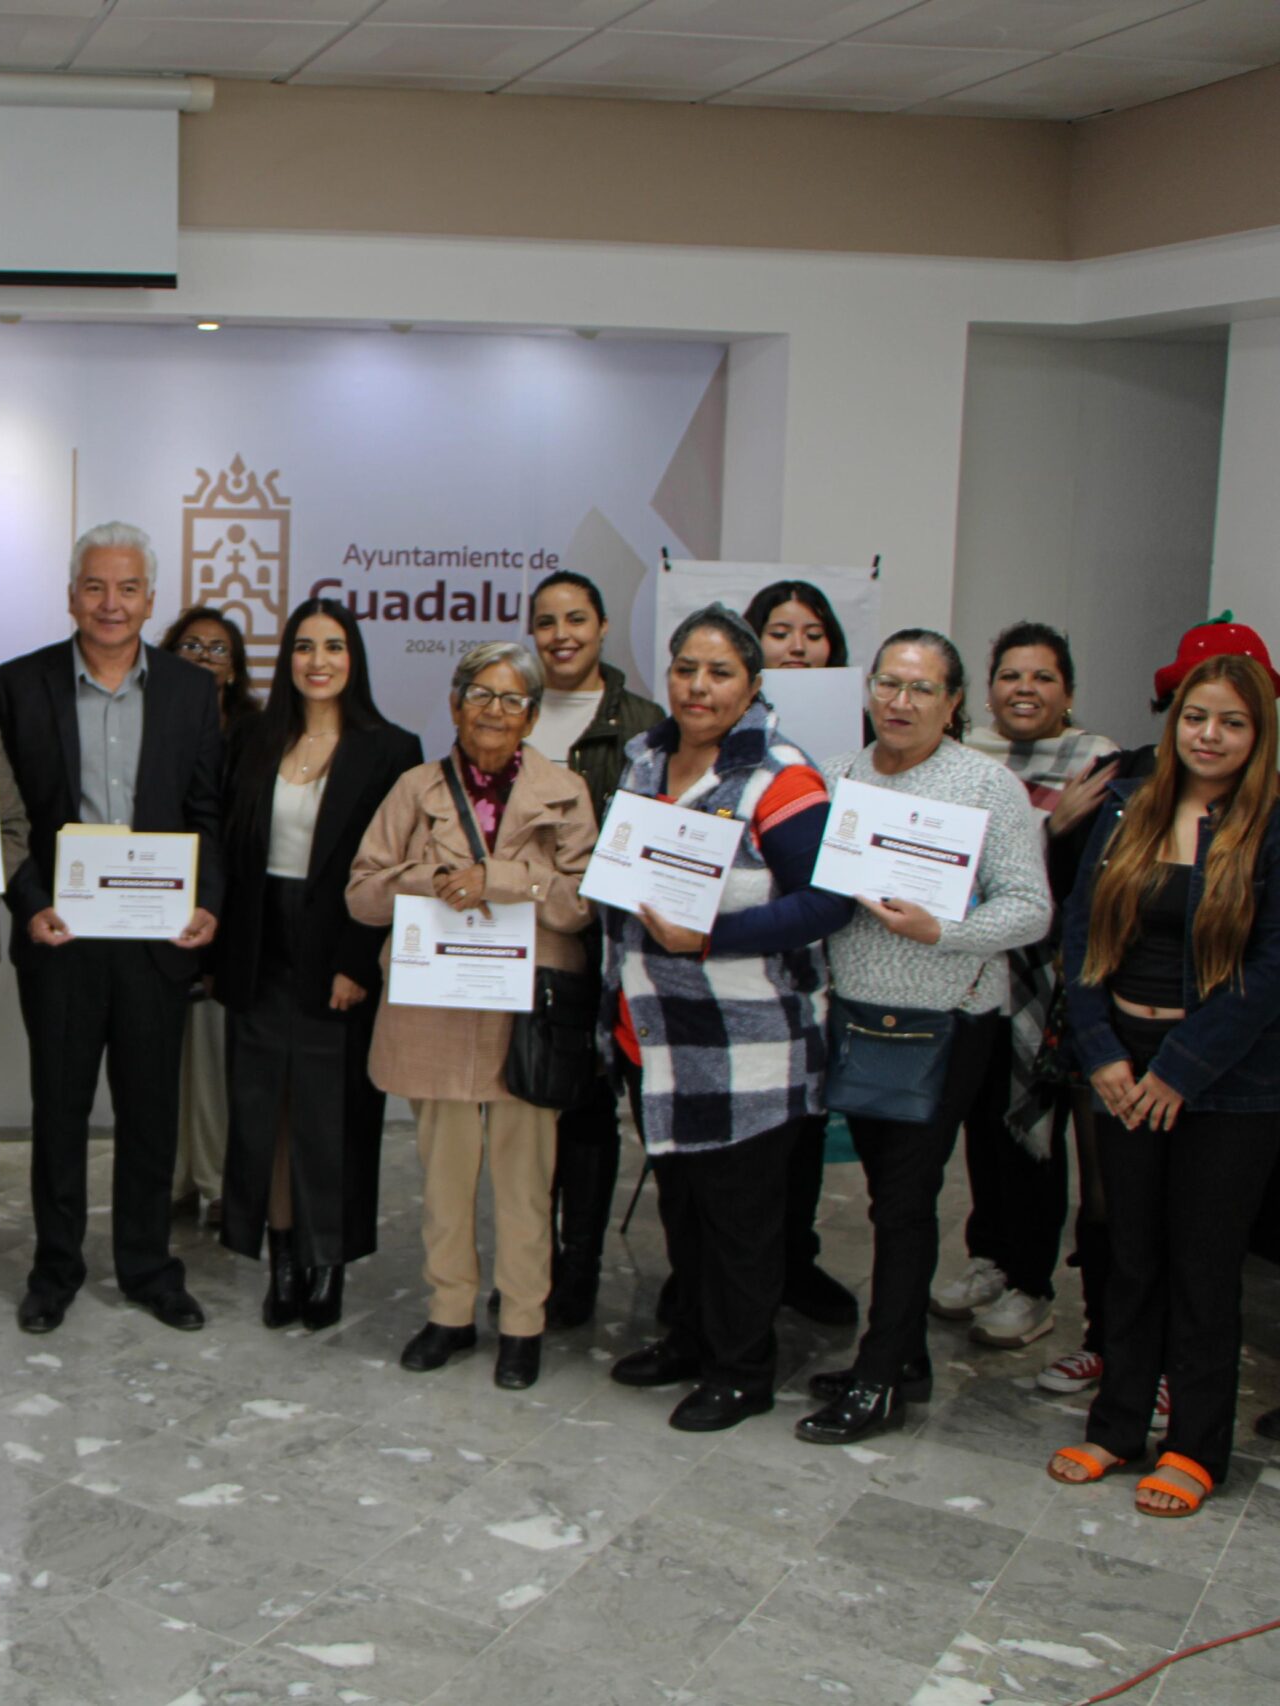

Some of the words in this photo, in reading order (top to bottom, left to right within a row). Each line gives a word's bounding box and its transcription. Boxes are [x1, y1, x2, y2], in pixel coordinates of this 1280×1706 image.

[342, 544, 524, 571] Ayuntamiento
[529, 549, 560, 569] de
[405, 639, 446, 654] 2024
